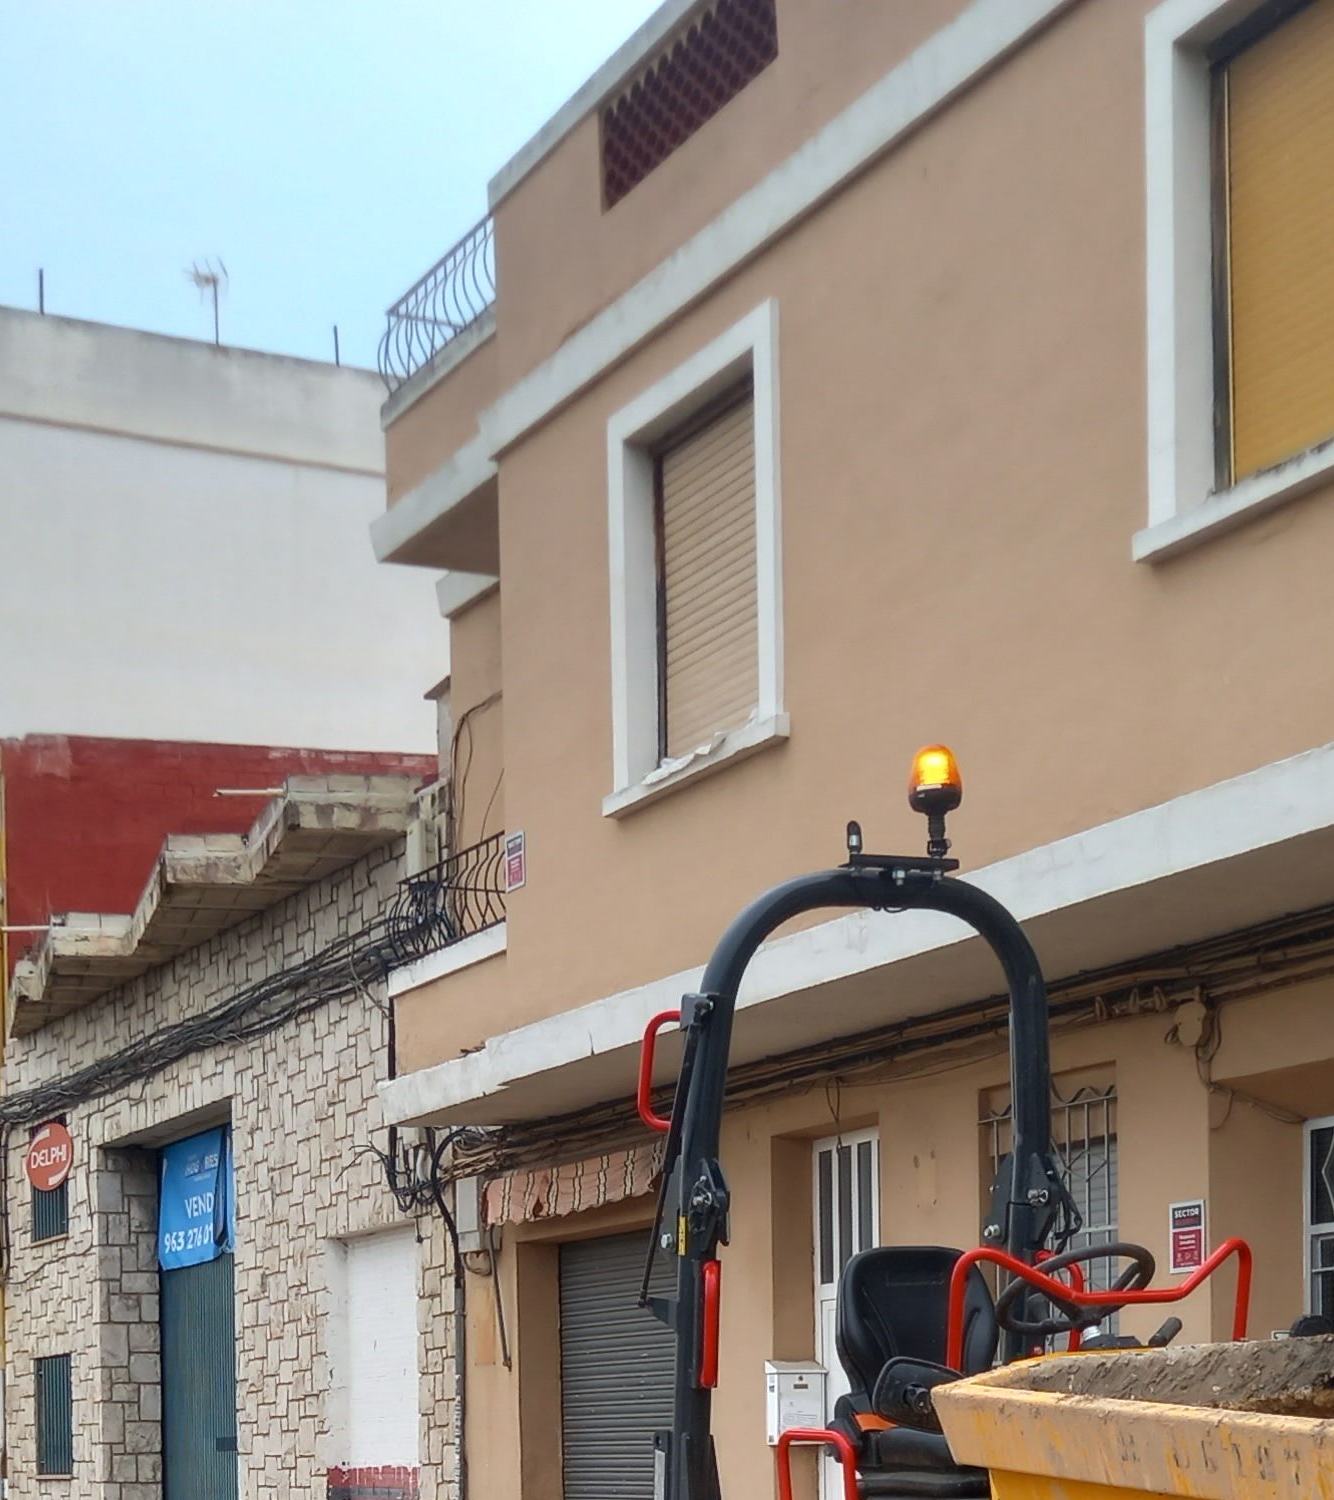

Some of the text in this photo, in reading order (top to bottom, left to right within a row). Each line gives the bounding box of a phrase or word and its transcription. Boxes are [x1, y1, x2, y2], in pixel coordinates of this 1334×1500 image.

[30, 1144, 67, 1169] DELPHI
[1173, 1207, 1199, 1219] SECTOR
[164, 1230, 186, 1253] 963
